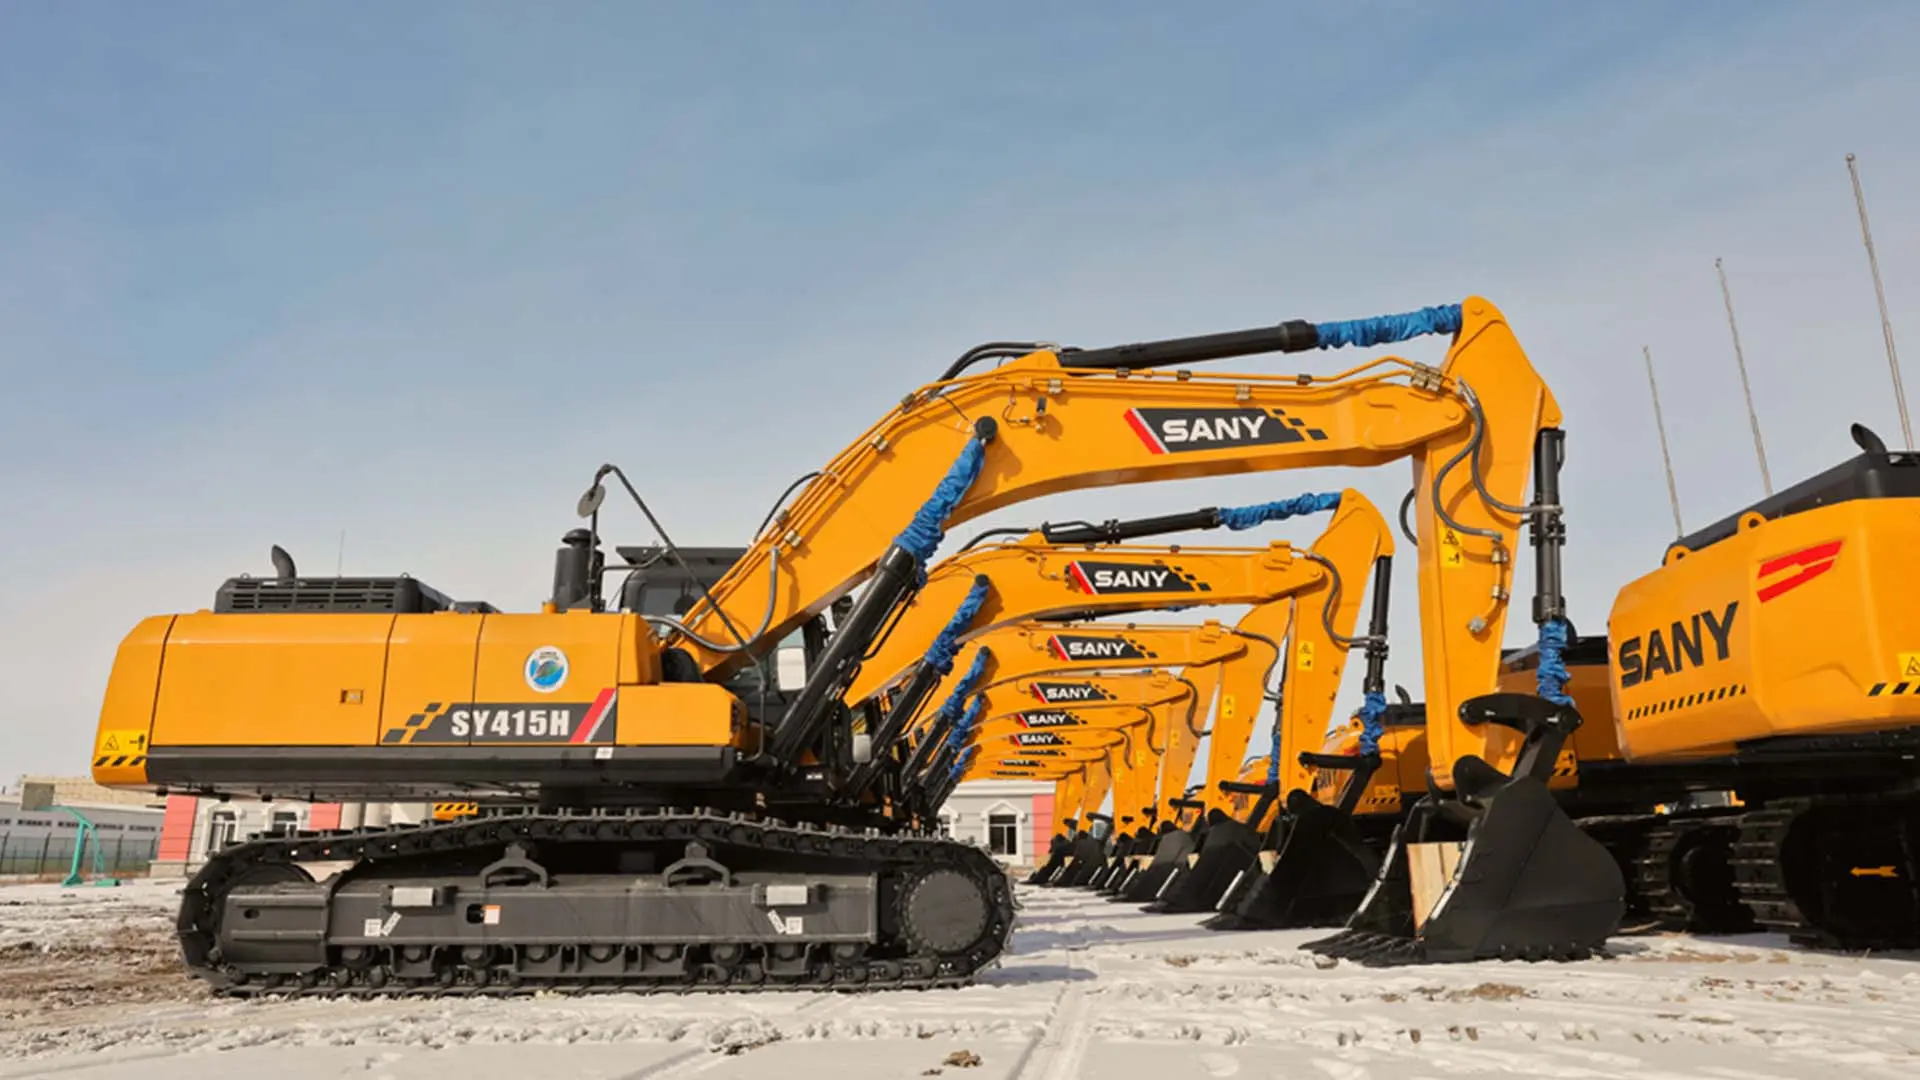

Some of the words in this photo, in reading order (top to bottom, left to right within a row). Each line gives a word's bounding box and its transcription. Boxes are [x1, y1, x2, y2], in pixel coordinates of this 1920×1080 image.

[1162, 416, 1266, 442] SANY
[1094, 570, 1169, 588] SANY
[1069, 642, 1125, 656] SANY
[1618, 600, 1739, 689] SANY
[1046, 687, 1092, 699] SANY
[451, 710, 570, 736] SY415H
[1028, 714, 1066, 724] SANY
